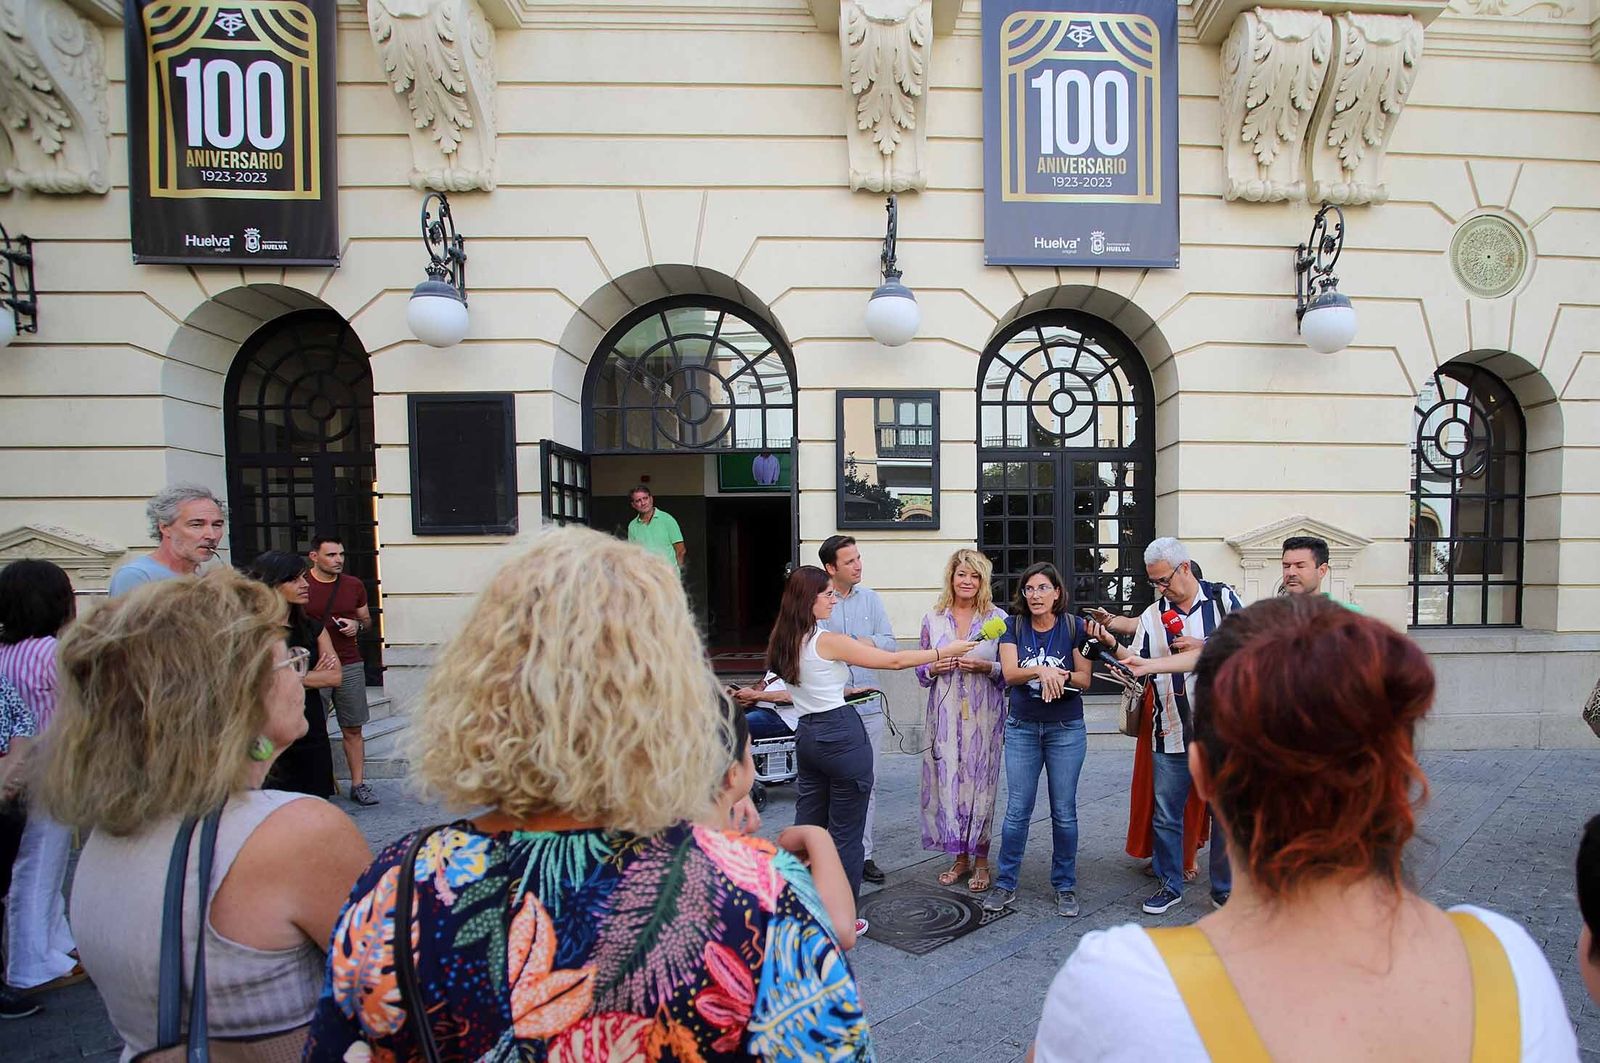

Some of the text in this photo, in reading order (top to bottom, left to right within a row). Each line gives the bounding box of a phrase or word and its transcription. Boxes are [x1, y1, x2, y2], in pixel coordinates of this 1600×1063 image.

[176, 58, 286, 150] 100
[1031, 69, 1129, 156] 100
[186, 150, 283, 170] ANIVERSARIO
[1037, 156, 1127, 175] ANIVERSARIO
[201, 170, 268, 183] 1923-2023
[1052, 177, 1112, 188] 1923-2023
[185, 234, 230, 247] Huelva
[1034, 237, 1077, 249] Huelva
